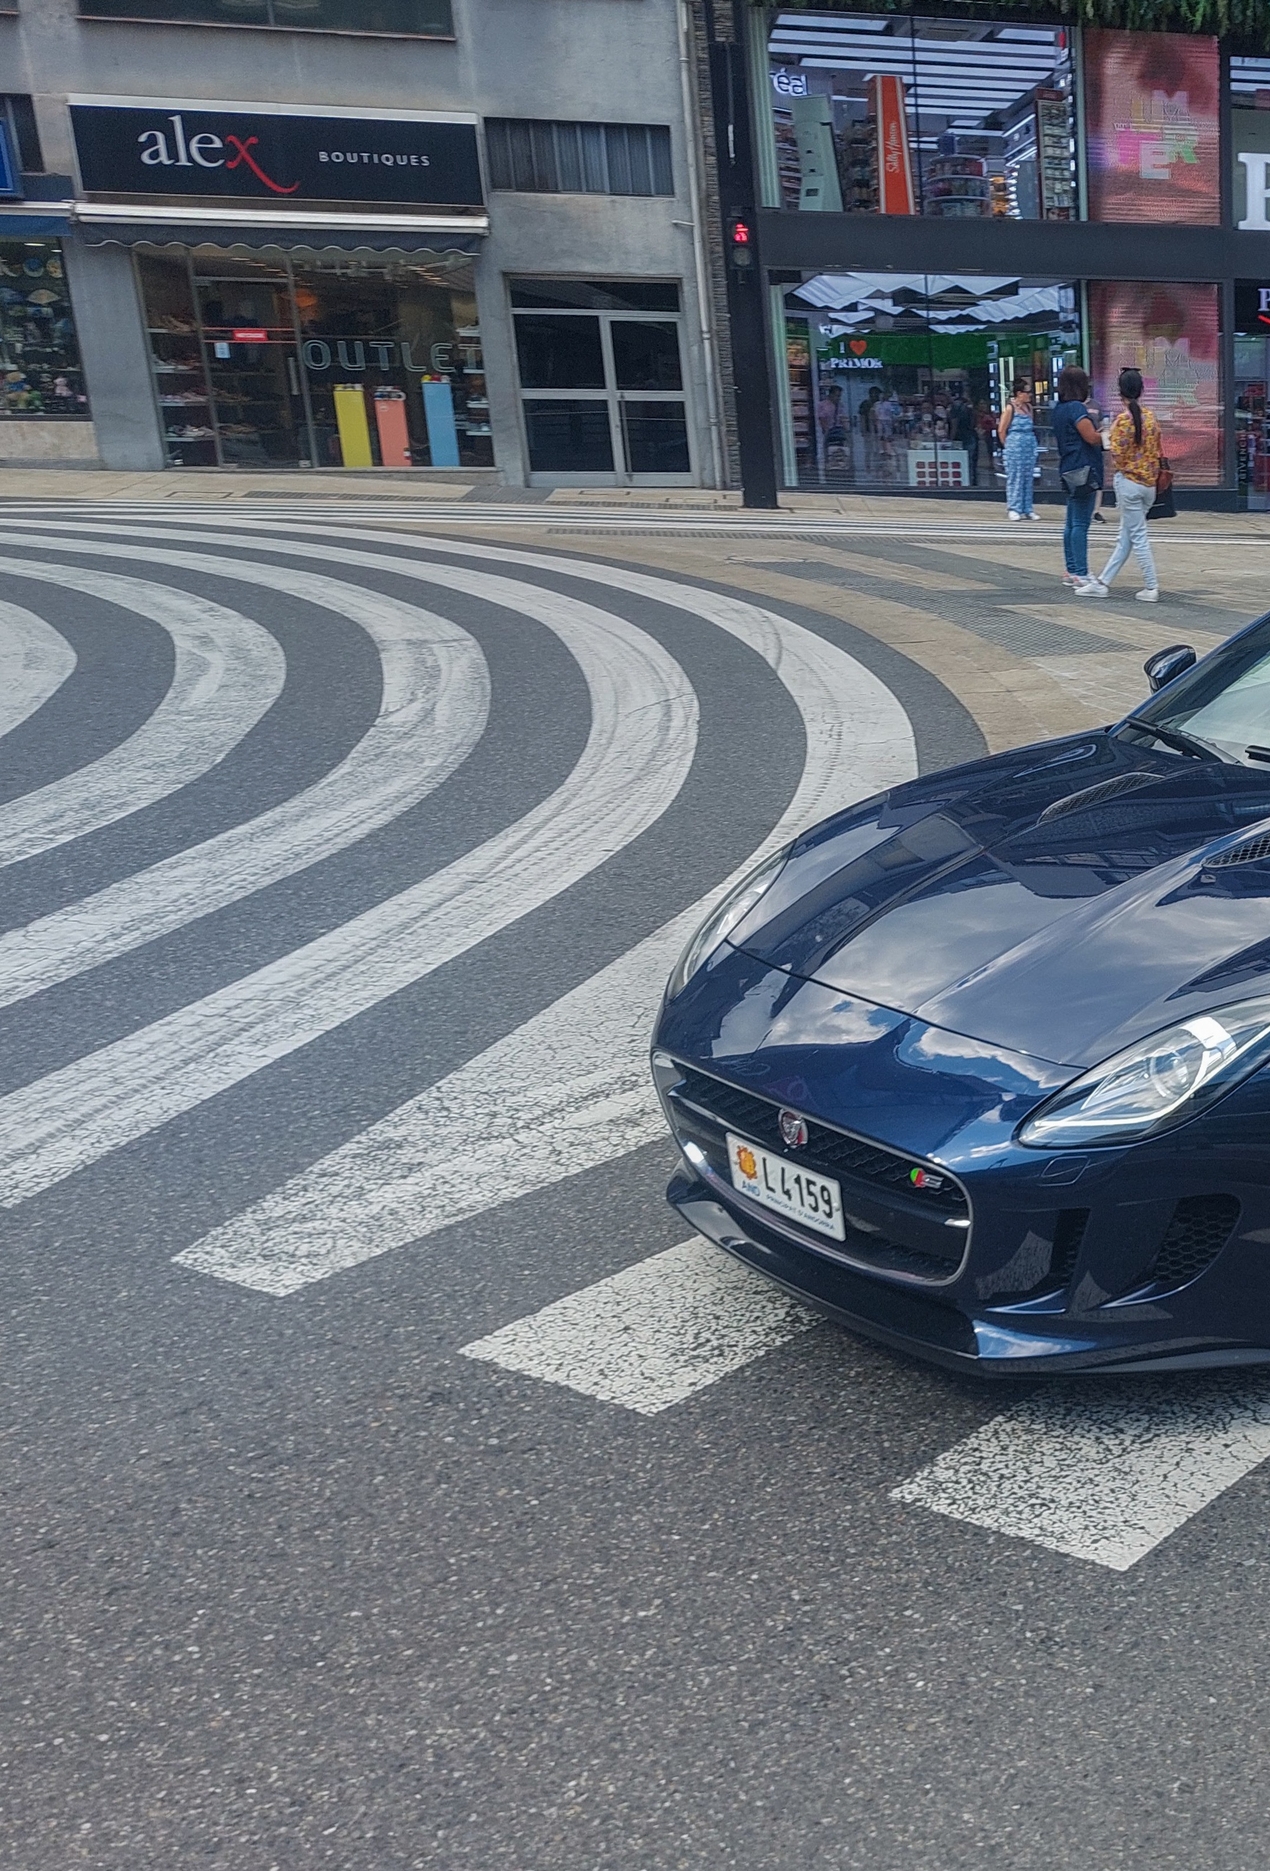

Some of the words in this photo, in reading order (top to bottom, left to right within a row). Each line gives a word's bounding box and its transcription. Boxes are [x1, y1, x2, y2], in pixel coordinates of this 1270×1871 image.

[137, 114, 300, 193] alex
[318, 151, 431, 167] BOUTIQUES
[302, 339, 482, 373] OUTLET
[830, 358, 883, 368] PRIMOR
[762, 1157, 833, 1219] L4159
